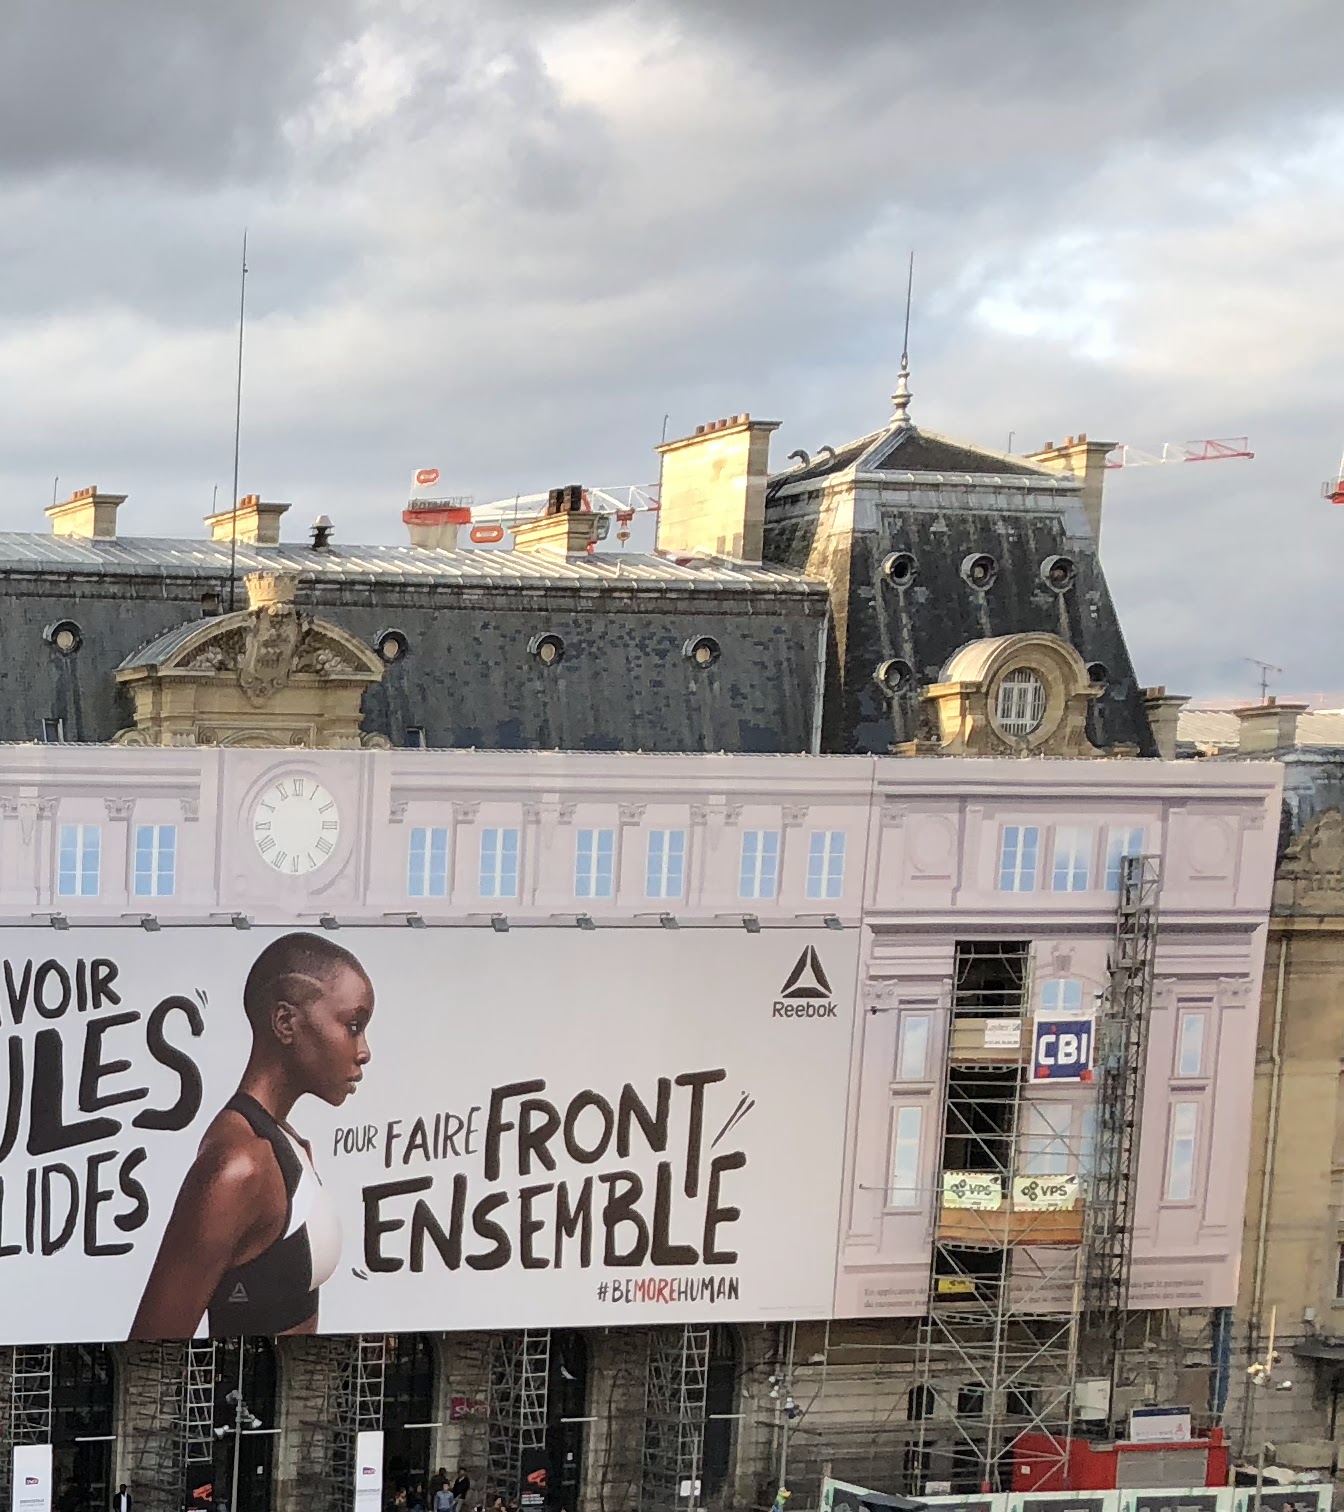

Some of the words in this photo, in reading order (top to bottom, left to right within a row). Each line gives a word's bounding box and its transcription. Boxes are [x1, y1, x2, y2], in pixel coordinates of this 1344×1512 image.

[772, 1000, 837, 1018] Reebok
[1037, 1033, 1088, 1065] CBI
[333, 1124, 378, 1156] POUR
[383, 1106, 481, 1168] FAIRE
[485, 1068, 727, 1198] FRONT
[969, 1184, 992, 1196] VPS
[1040, 1185, 1068, 1197] VPS
[361, 1151, 747, 1275] ENSEMBLE
[597, 1275, 739, 1304] #BEMOREHUMAN
